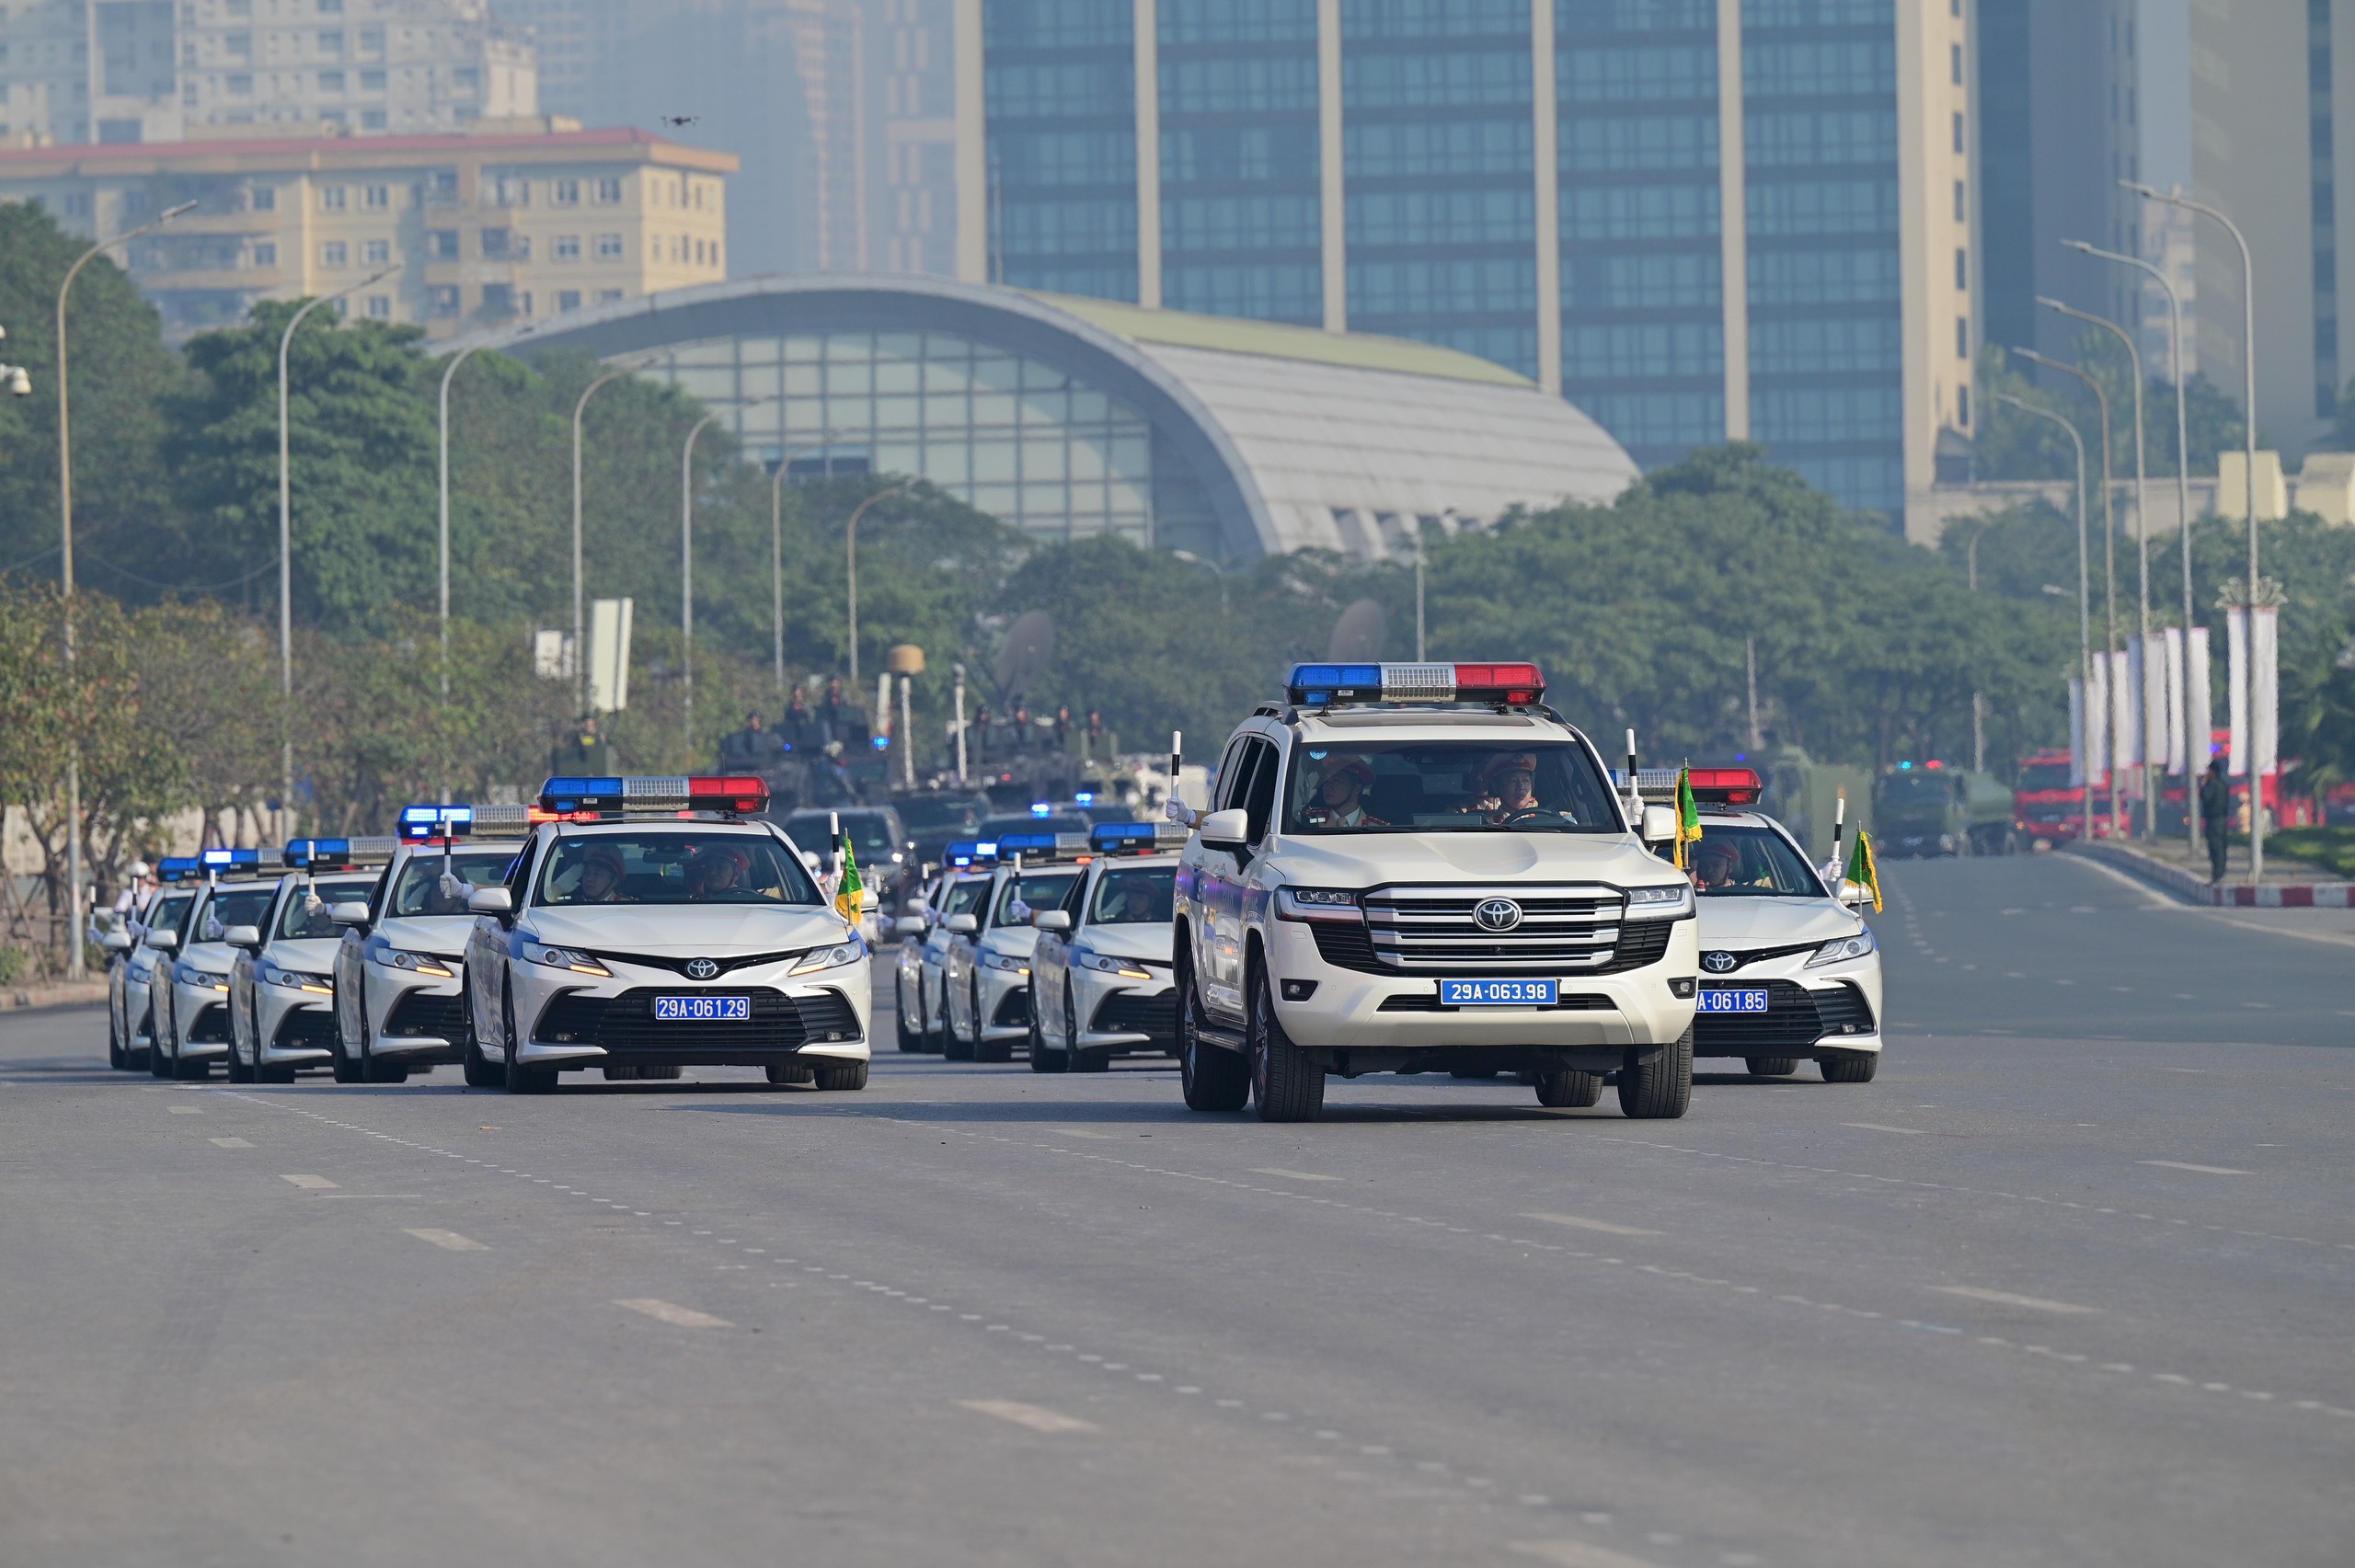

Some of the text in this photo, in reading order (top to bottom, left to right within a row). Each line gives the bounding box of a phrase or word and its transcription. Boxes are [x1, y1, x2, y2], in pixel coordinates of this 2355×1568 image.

[1452, 984, 1546, 1000] 29A-063.98
[659, 1000, 746, 1017] 29A-061.29
[1697, 992, 1764, 1010] A-061.85
